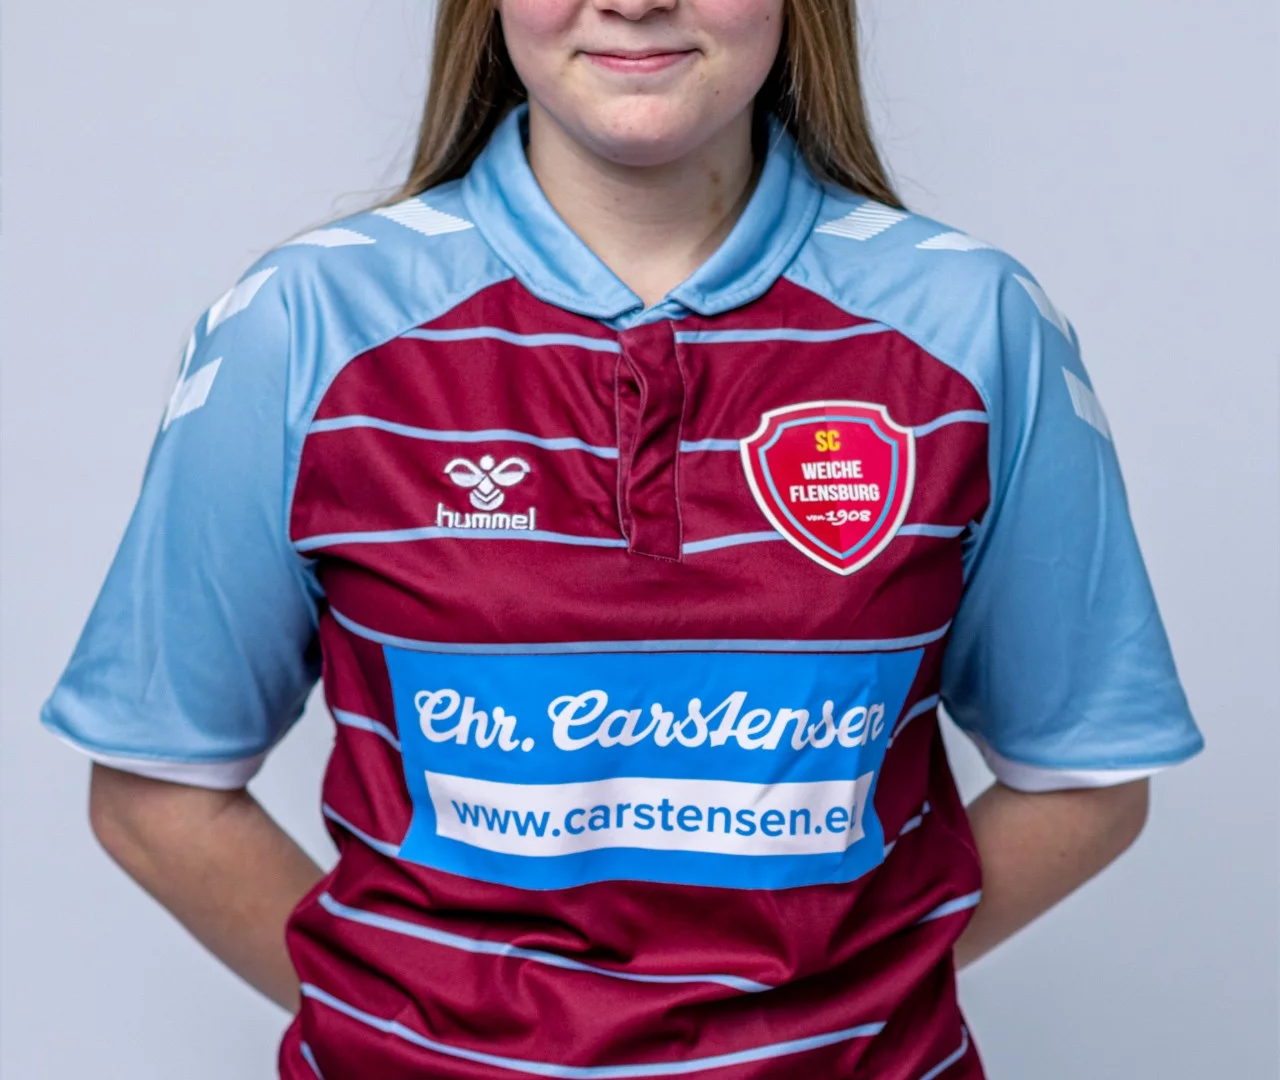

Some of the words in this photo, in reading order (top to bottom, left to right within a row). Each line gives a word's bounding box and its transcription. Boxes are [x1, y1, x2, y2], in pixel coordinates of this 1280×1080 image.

[815, 429, 841, 452] SC
[801, 460, 864, 480] WEICHE
[789, 483, 880, 503] FLENSBURG
[436, 502, 536, 531] hummel
[825, 509, 872, 526] 1908
[414, 689, 534, 752] Chr.
[546, 690, 884, 751] Carstensen
